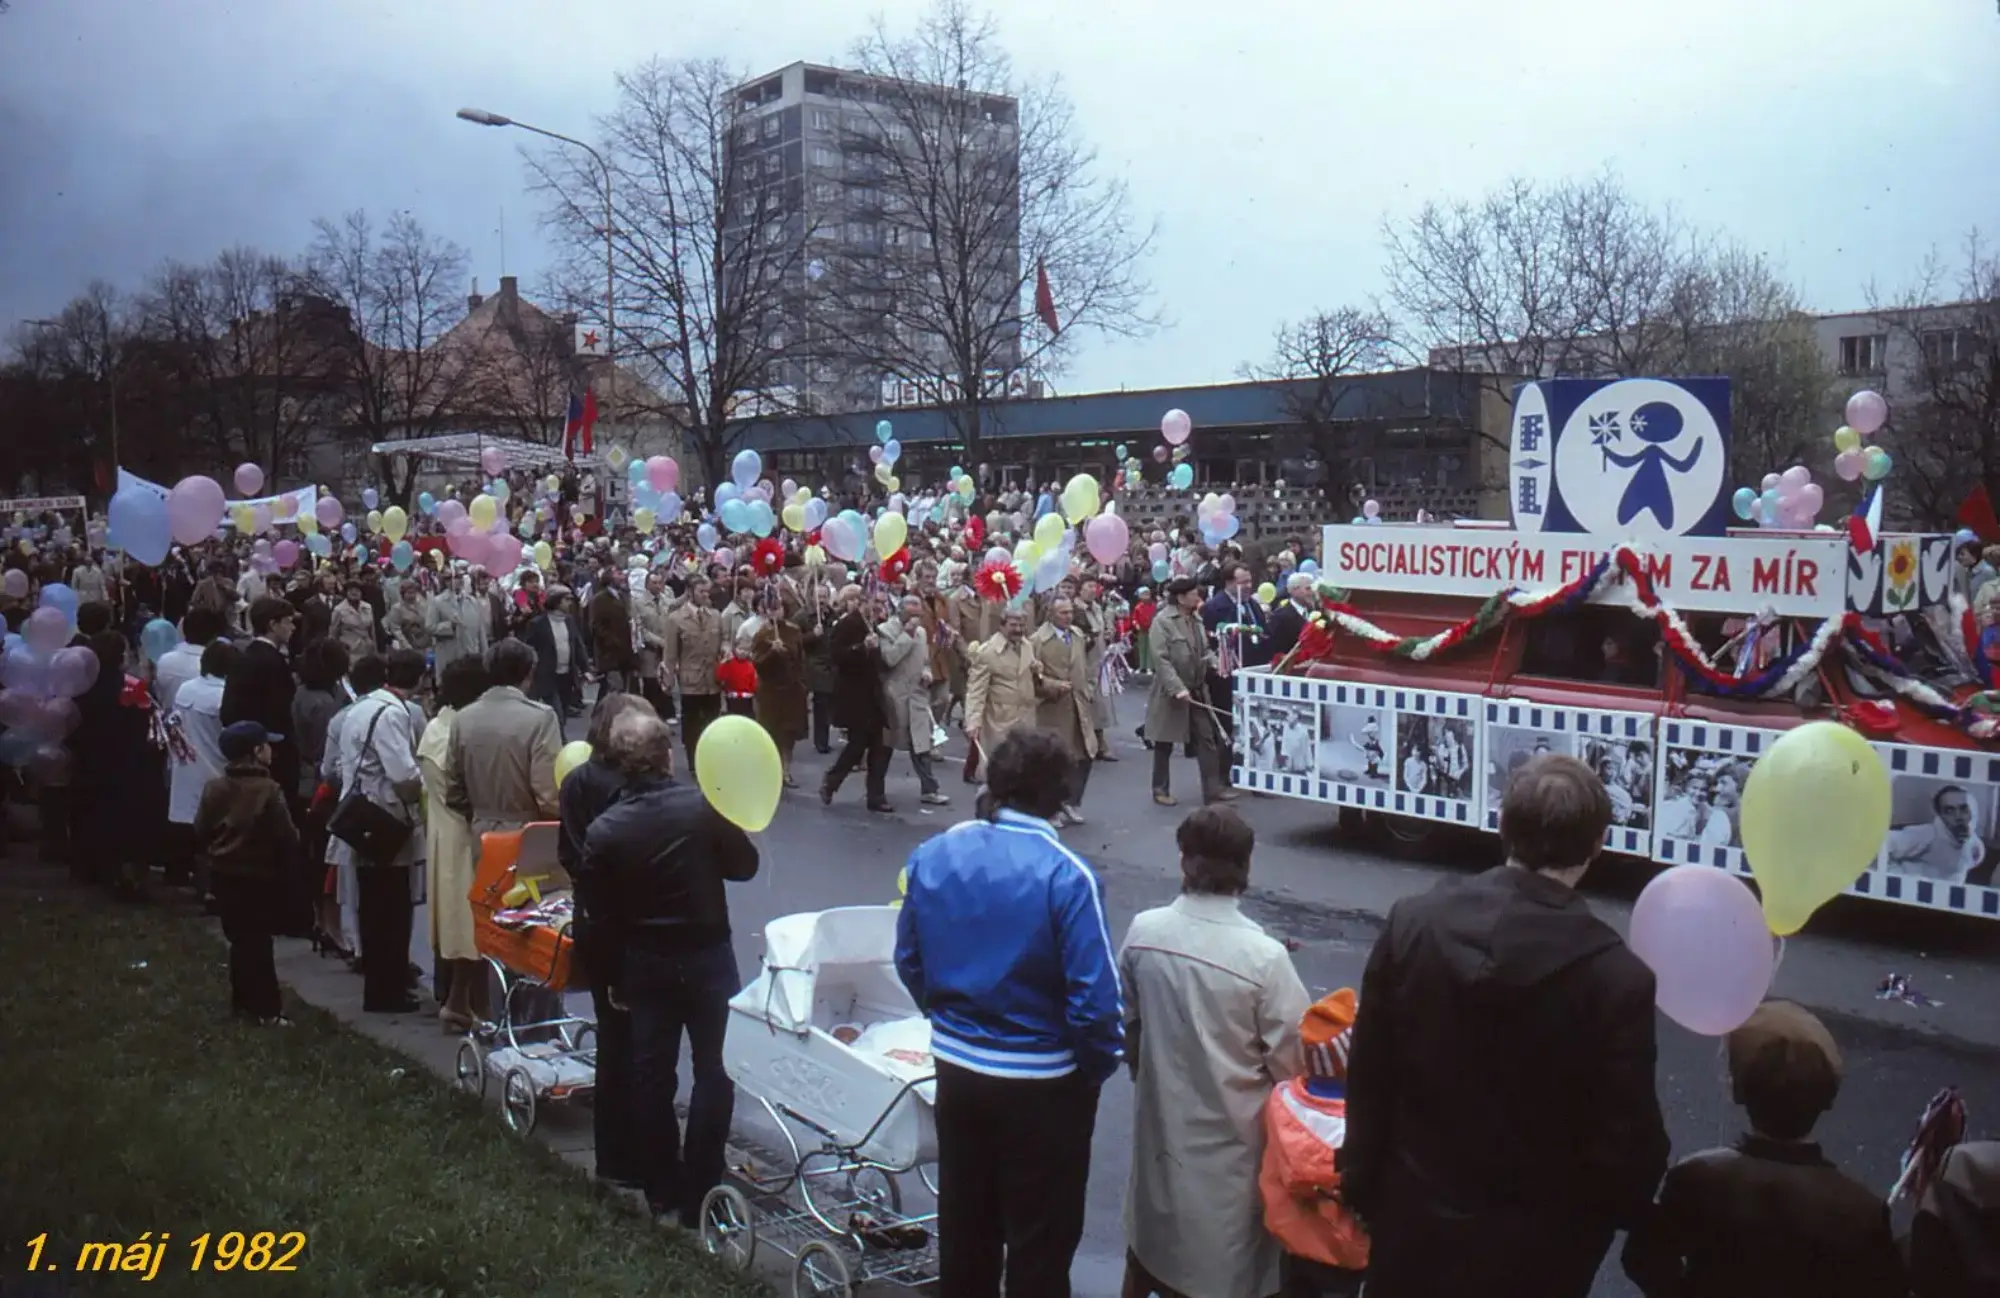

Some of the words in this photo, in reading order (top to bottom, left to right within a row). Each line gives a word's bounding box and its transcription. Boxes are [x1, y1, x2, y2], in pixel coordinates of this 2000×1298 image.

[881, 370, 1028, 406] JEDNTA
[1339, 540, 1545, 582] SOCIALISTICKÝM
[1560, 550, 1673, 589] FIM
[1690, 555, 1731, 592] ZA
[1752, 549, 1818, 596] MÍR
